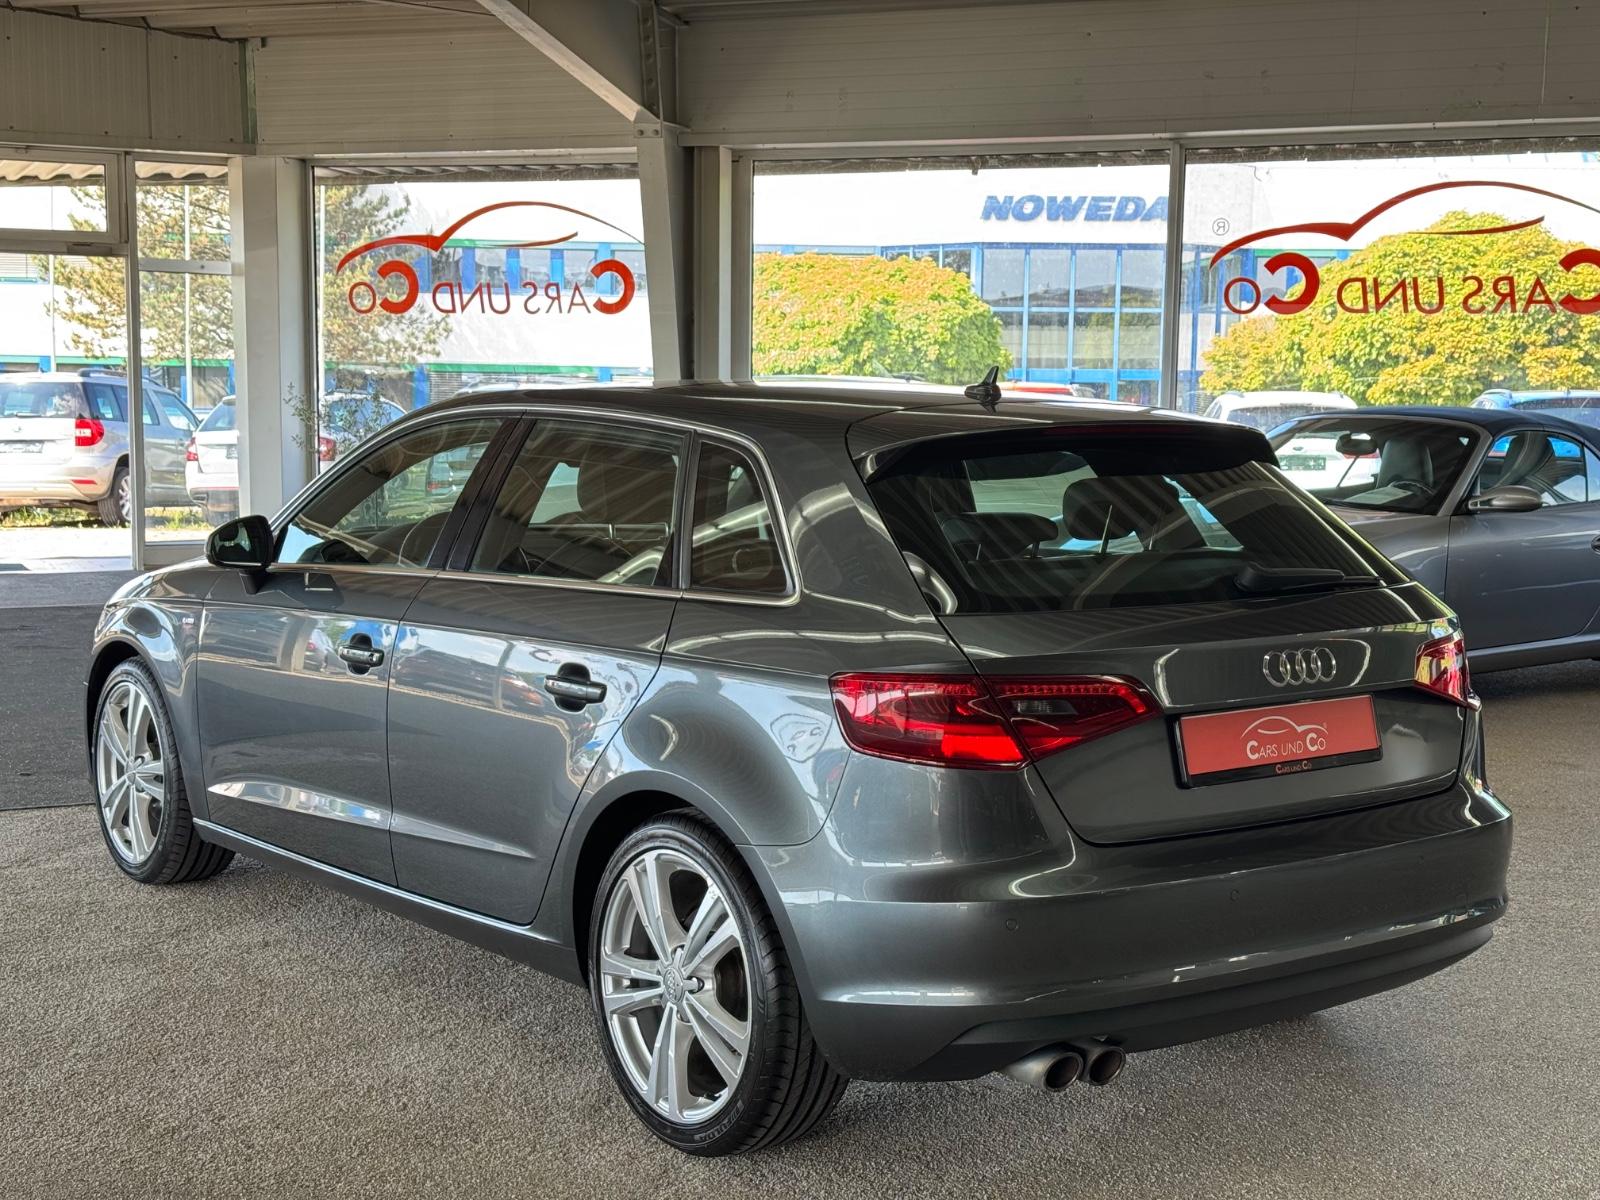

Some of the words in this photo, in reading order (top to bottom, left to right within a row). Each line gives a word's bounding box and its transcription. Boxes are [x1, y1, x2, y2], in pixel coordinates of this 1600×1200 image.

[980, 194, 1169, 222] NOWEDA
[1246, 740, 1278, 760] CARS
[1281, 741, 1304, 756] UND
[1306, 732, 1326, 752] CO
